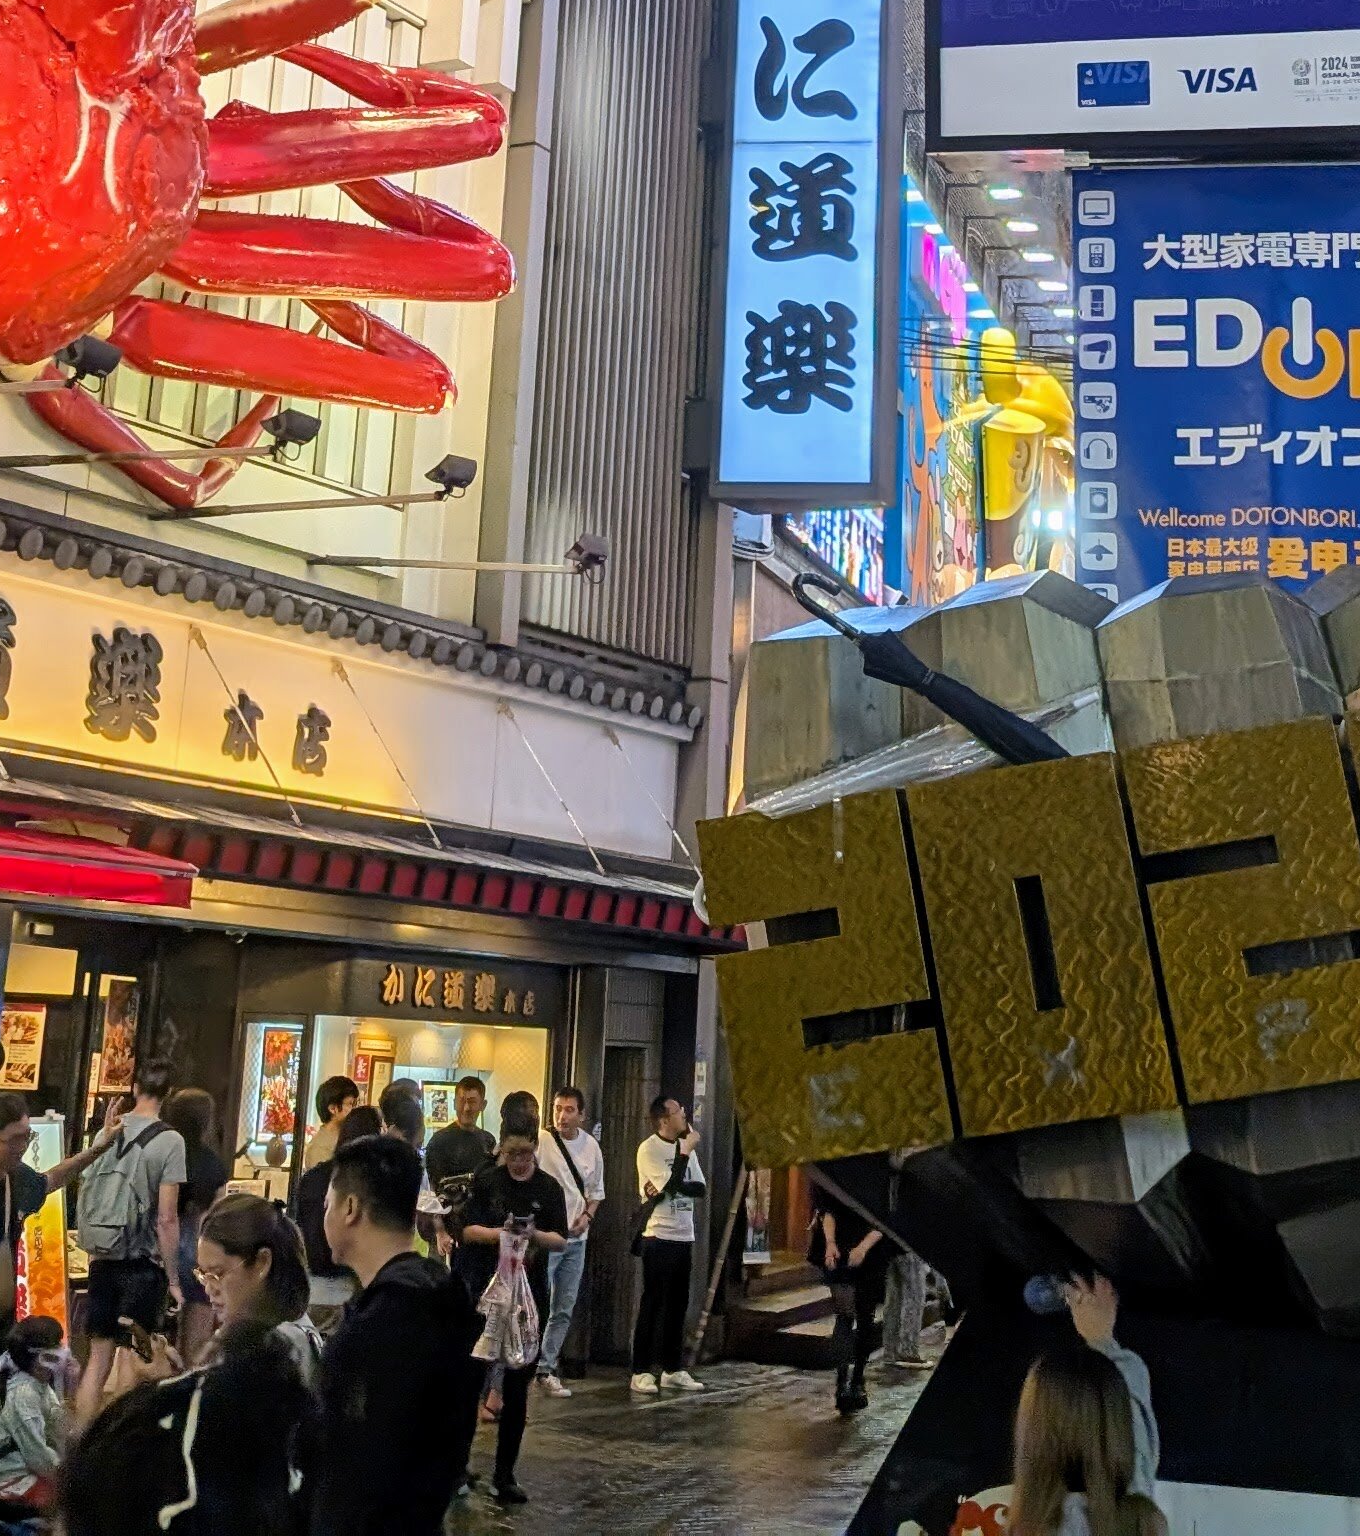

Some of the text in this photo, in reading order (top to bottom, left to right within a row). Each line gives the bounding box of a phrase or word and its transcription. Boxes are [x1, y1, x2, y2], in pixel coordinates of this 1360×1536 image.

[1321, 57, 1349, 71] 2024
[1177, 67, 1258, 94] VISA
[1139, 507, 1226, 528] Wellcome
